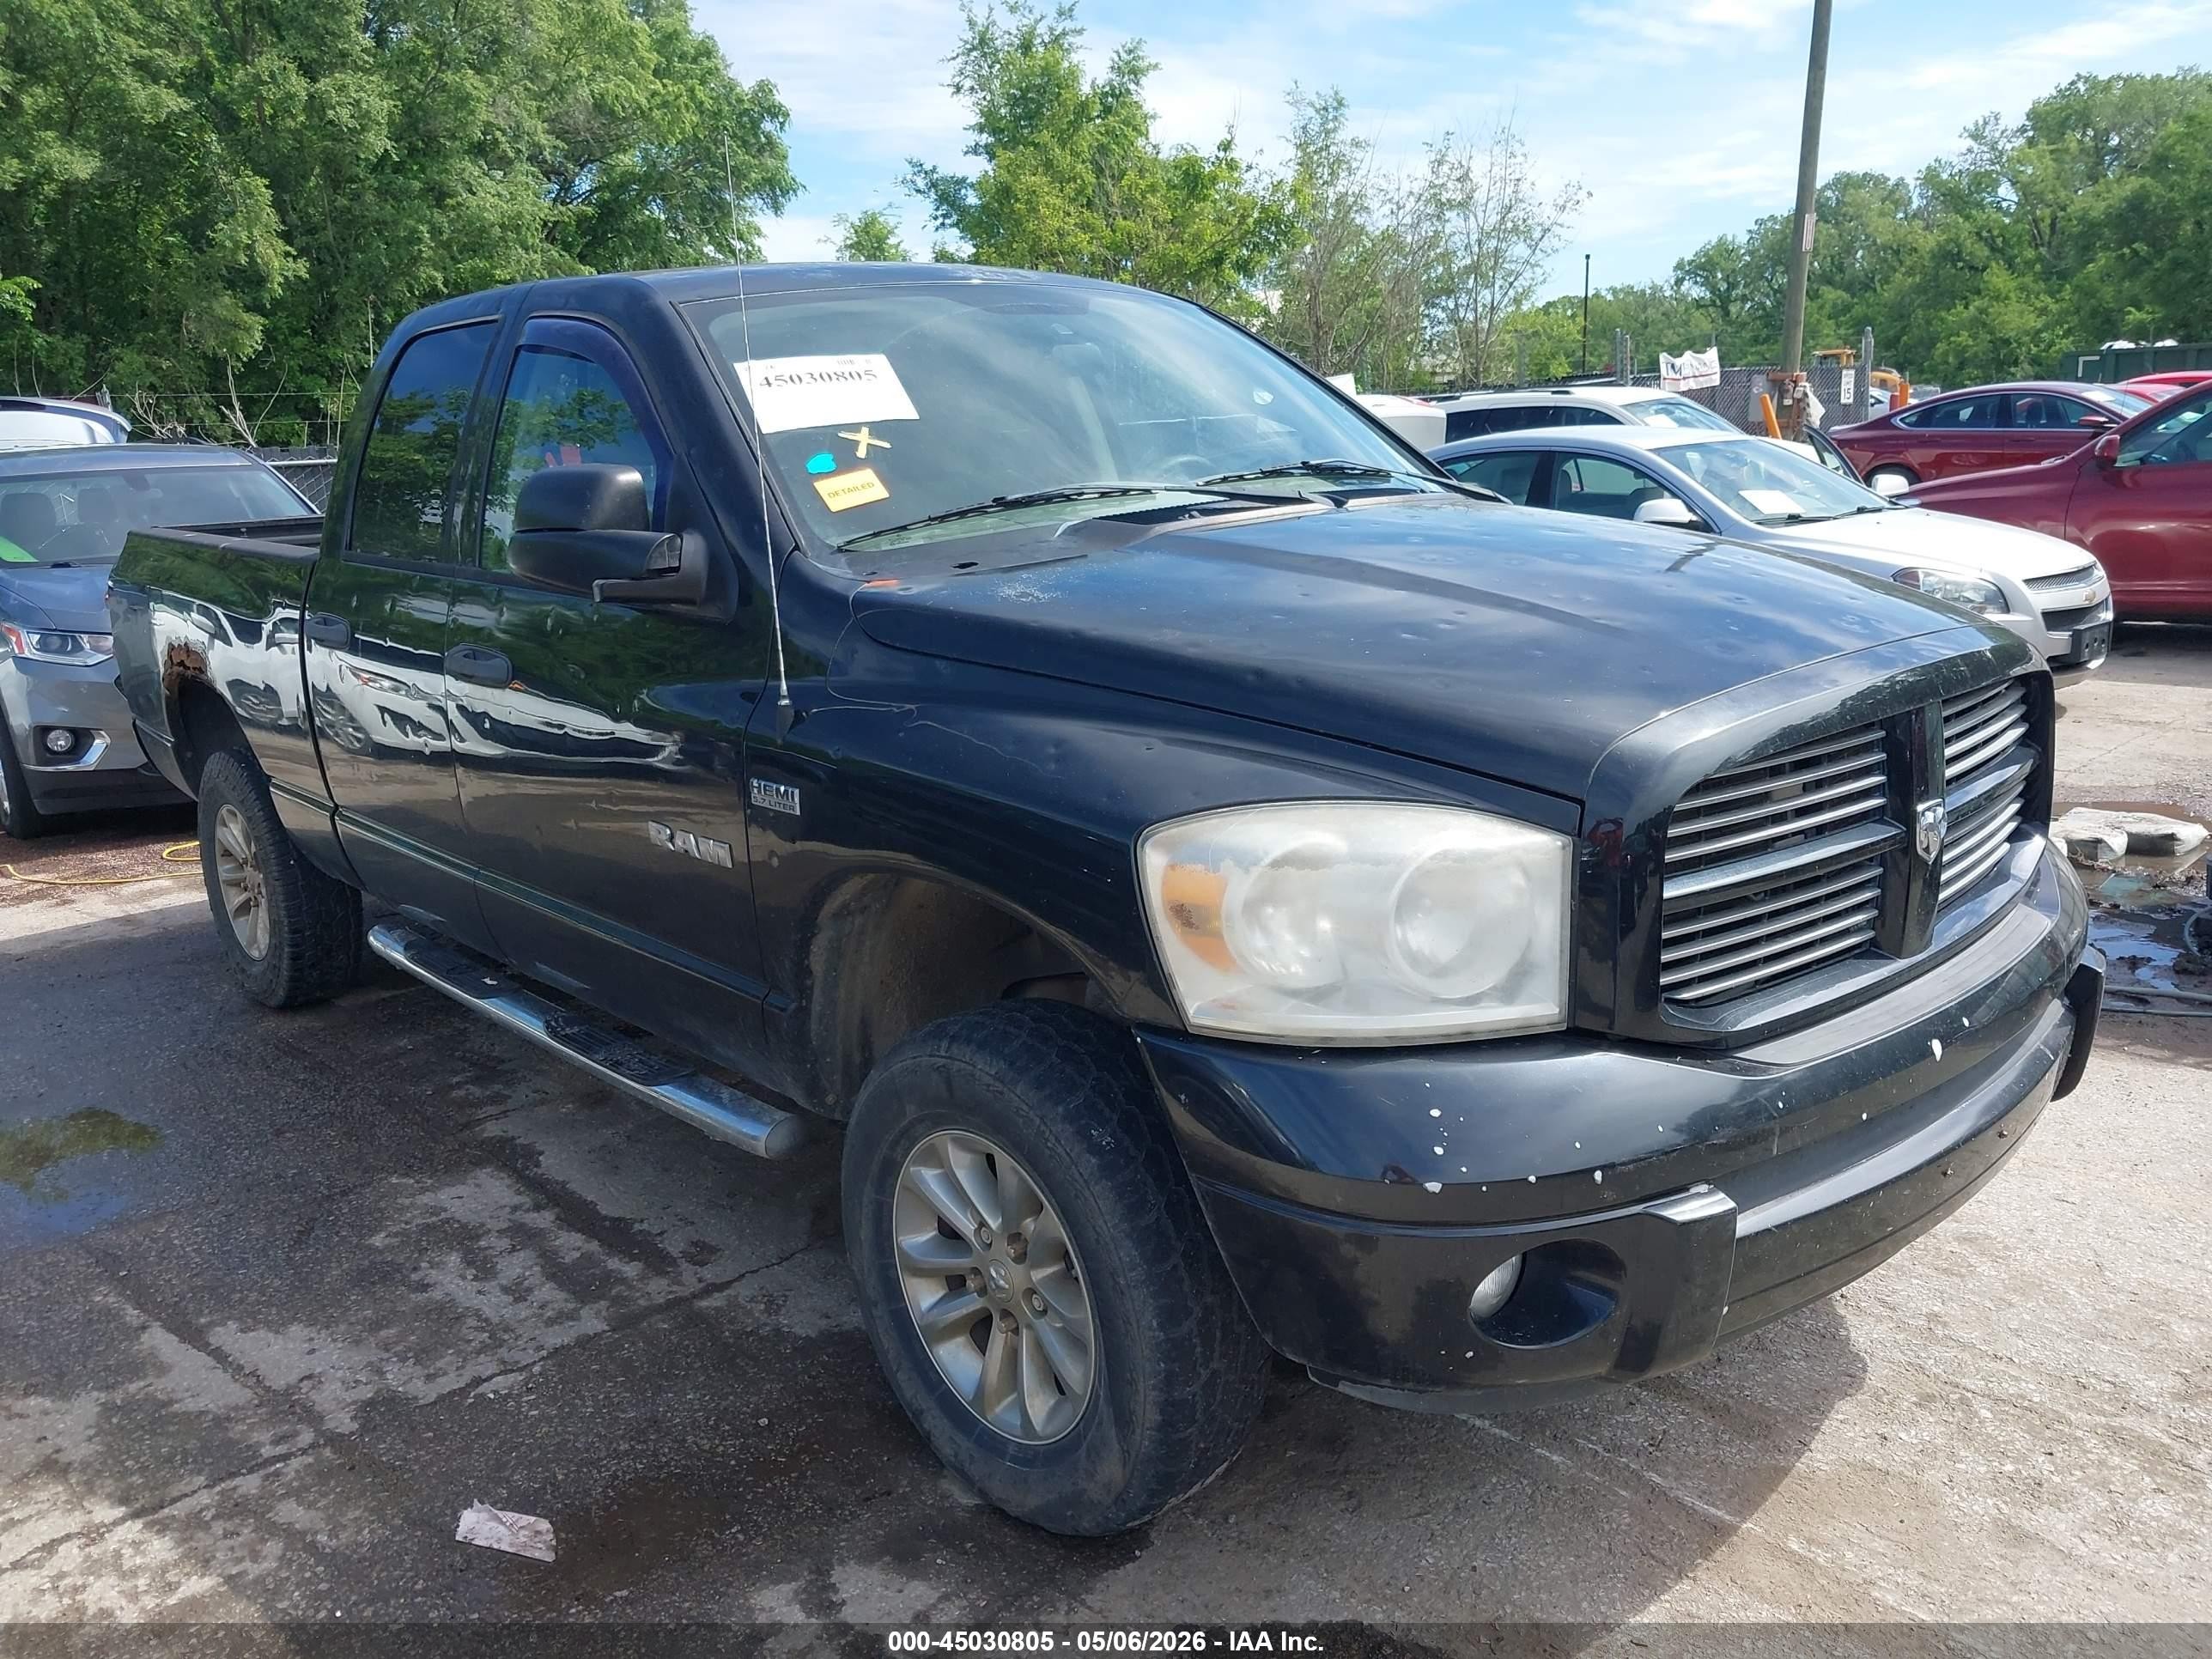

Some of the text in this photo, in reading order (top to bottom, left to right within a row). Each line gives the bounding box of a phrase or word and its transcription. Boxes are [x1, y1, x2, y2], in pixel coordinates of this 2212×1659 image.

[759, 369, 878, 388] 45030805
[1844, 387, 1852, 400] 15
[827, 481, 875, 499] DETAILED
[750, 777, 799, 804] HEMI
[752, 795, 796, 812] 5.7 LITER
[648, 820, 734, 869] RAM
